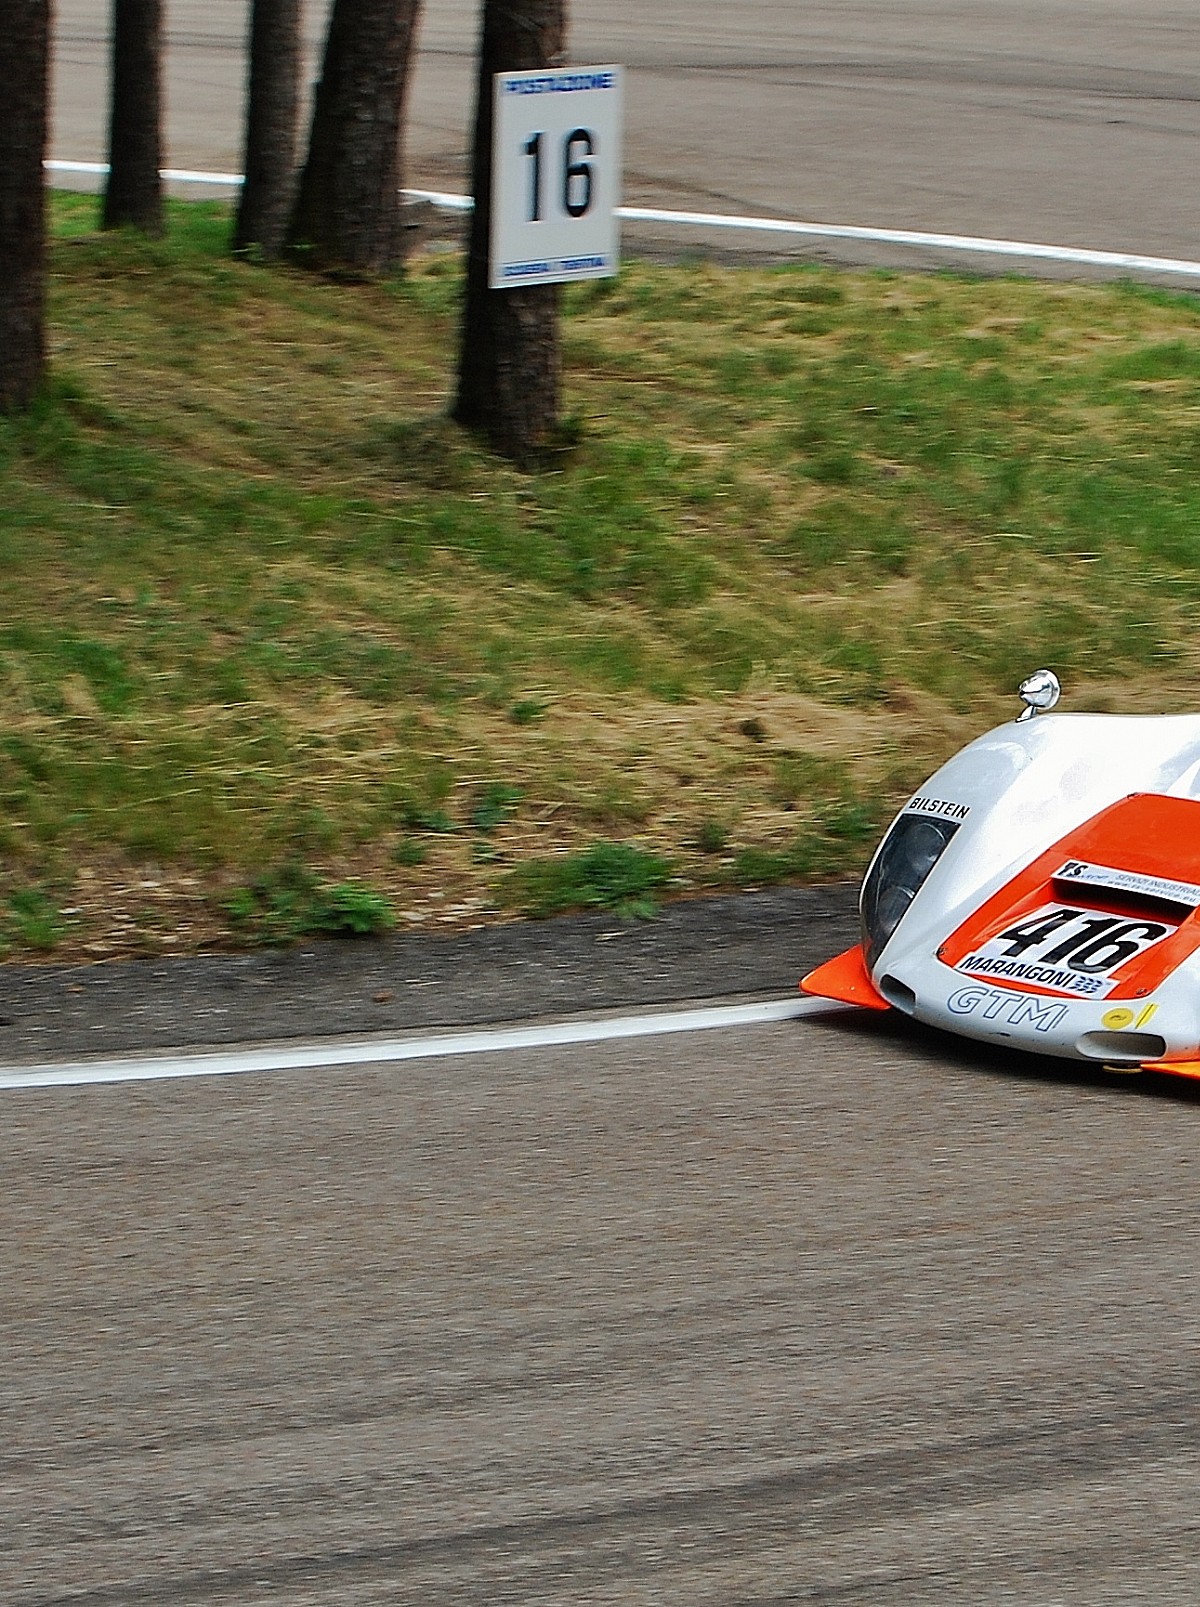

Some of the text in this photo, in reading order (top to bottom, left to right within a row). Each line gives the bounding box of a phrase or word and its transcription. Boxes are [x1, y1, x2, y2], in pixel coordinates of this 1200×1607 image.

[522, 127, 594, 222] 16
[909, 797, 970, 819] BILSTEIN
[997, 908, 1167, 974] 416
[959, 956, 1077, 988] MARANGONI
[946, 985, 1069, 1032] GTM
